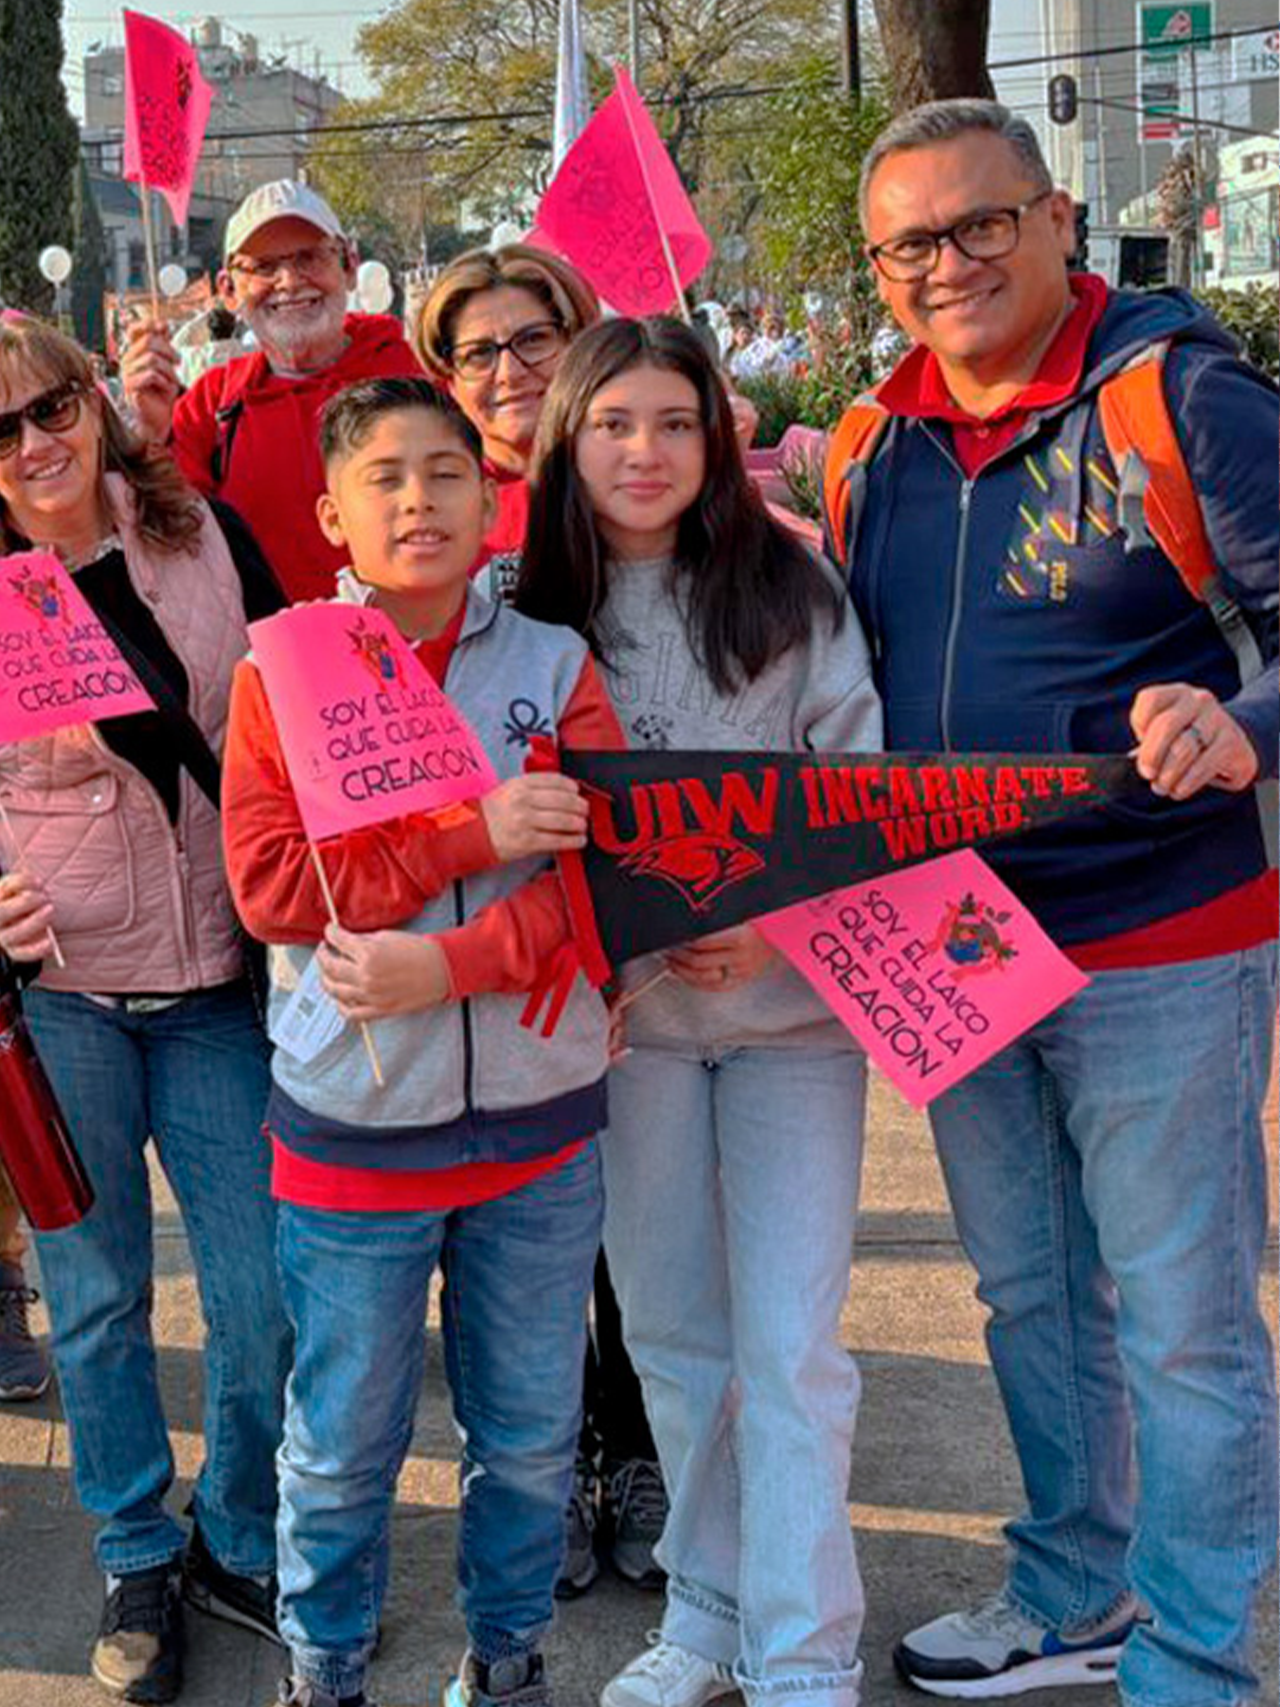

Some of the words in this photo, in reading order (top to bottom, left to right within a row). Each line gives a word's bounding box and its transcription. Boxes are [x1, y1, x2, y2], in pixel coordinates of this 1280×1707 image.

[3, 654, 43, 679] QUE
[40, 629, 61, 647] EL
[320, 697, 367, 730] SOY
[375, 693, 400, 716] EL
[327, 726, 381, 761] QUE
[439, 716, 462, 735] LA
[582, 767, 779, 854] UIW
[799, 766, 1091, 829] INCARNATE
[878, 803, 1024, 861] WORD
[862, 889, 909, 937] SOY
[901, 939, 929, 971] EL
[809, 930, 943, 1078] CREACIÓN
[838, 905, 887, 956] QUE
[880, 957, 936, 1024] CUIDA
[934, 1021, 964, 1056] LA
